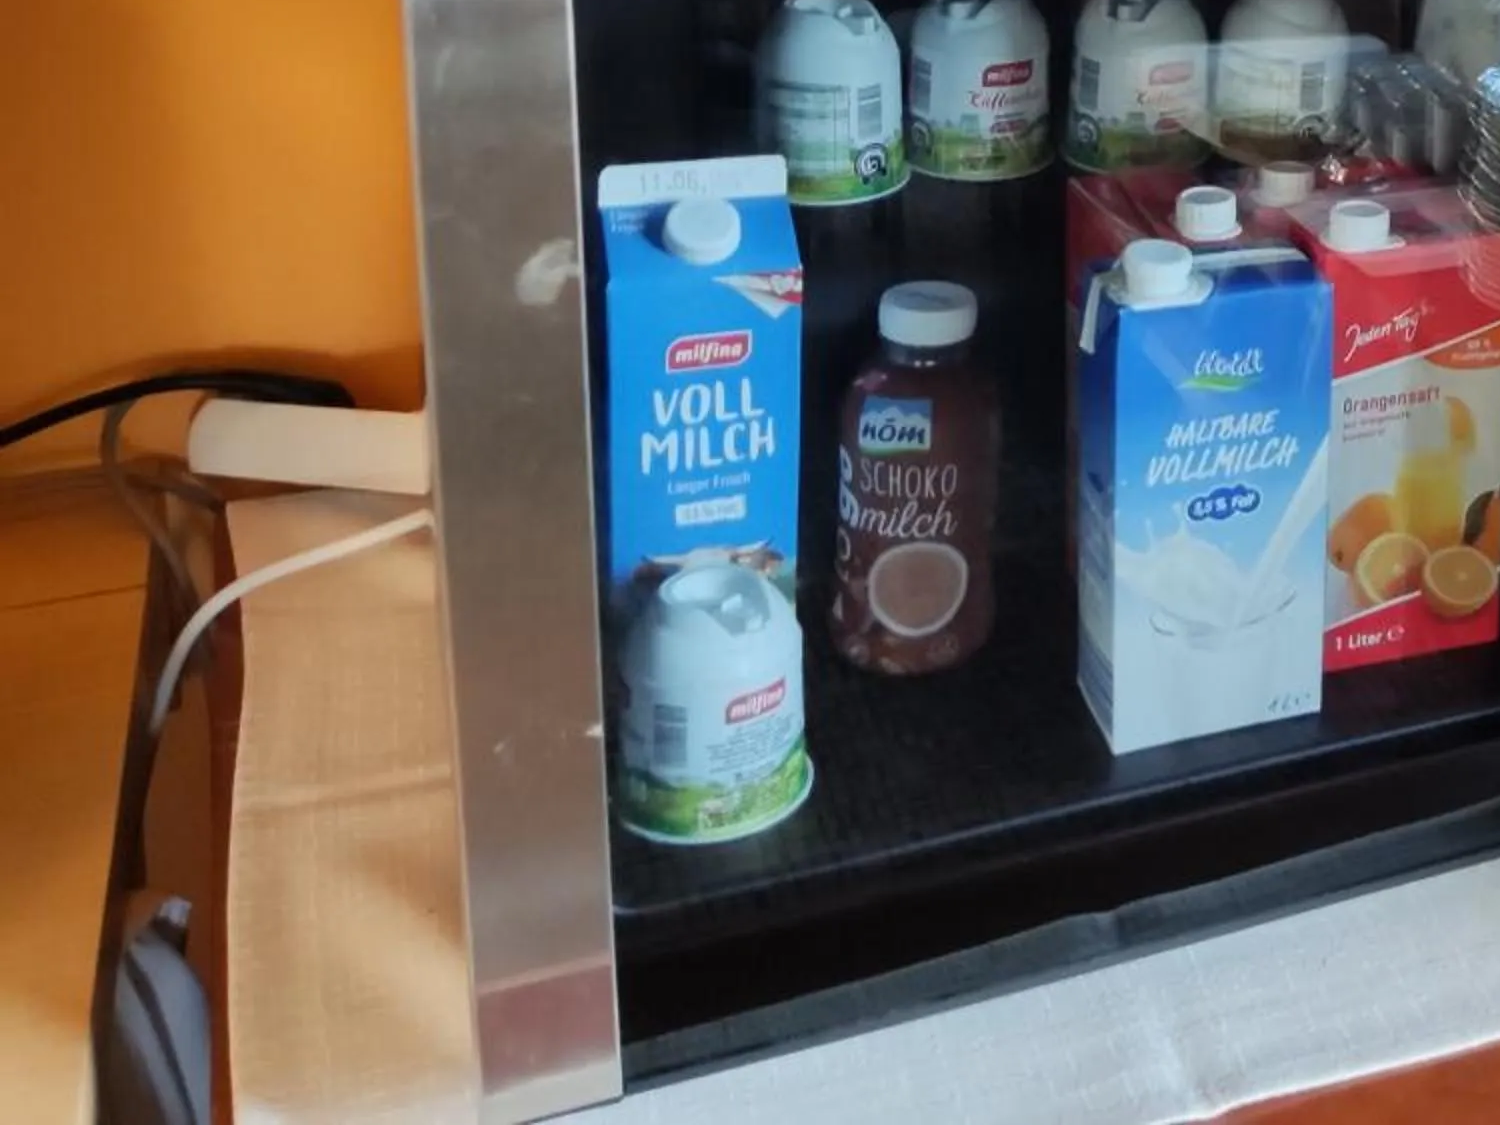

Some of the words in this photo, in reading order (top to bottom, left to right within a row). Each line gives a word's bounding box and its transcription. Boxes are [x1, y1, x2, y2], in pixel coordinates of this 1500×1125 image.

[674, 342, 744, 364] milfina
[1343, 322, 1391, 363] Jeden
[652, 376, 766, 426] VOLL
[1342, 386, 1441, 414] Orangensaft
[640, 416, 777, 476] MILCH
[1165, 408, 1281, 448] HALTBARE
[859, 457, 959, 500] SCHOKO
[1147, 433, 1299, 488] VOLLMILCH
[857, 499, 960, 539] milch
[1335, 636, 1343, 652] 1
[1348, 631, 1383, 650] Liter
